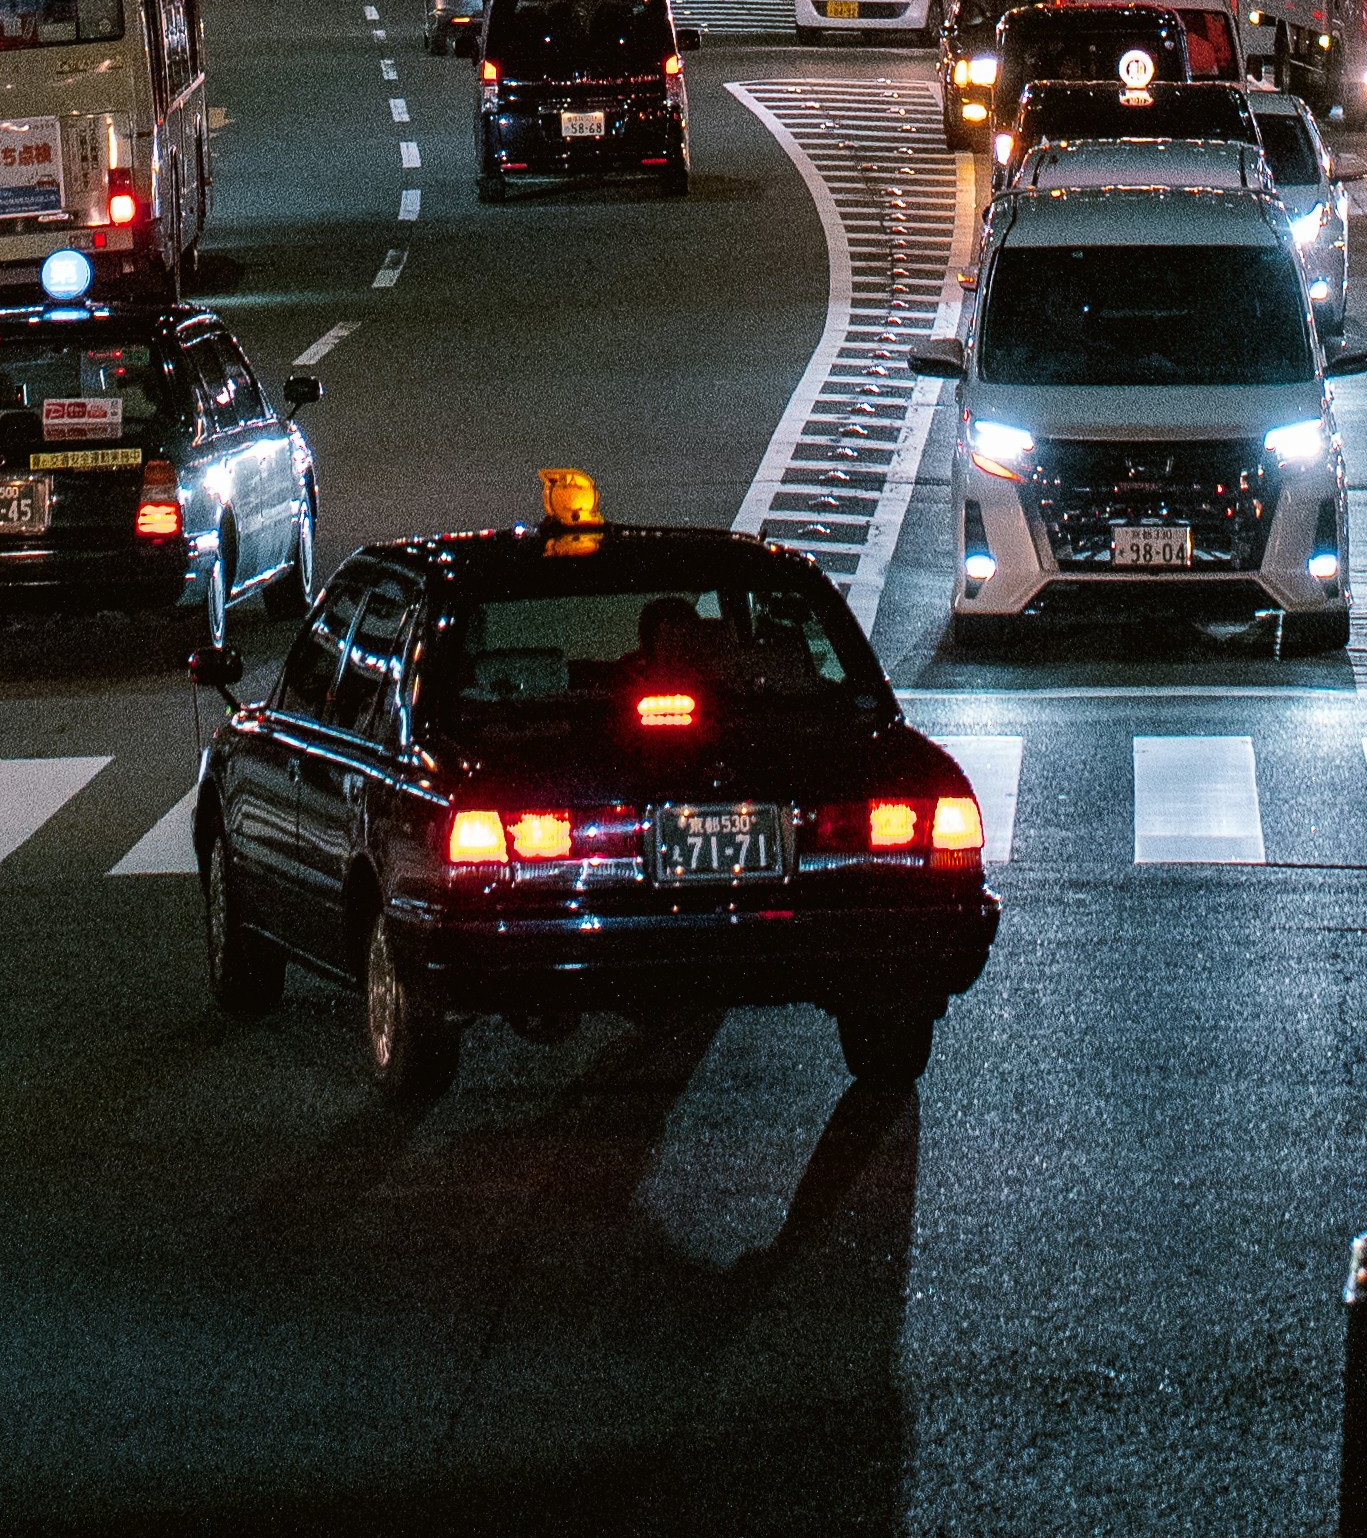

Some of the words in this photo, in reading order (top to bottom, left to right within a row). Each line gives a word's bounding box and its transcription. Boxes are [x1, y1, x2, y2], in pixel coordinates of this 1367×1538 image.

[1130, 542, 1186, 565] 98-04
[687, 814, 751, 835] 京都530
[687, 833, 767, 871] 71-71
